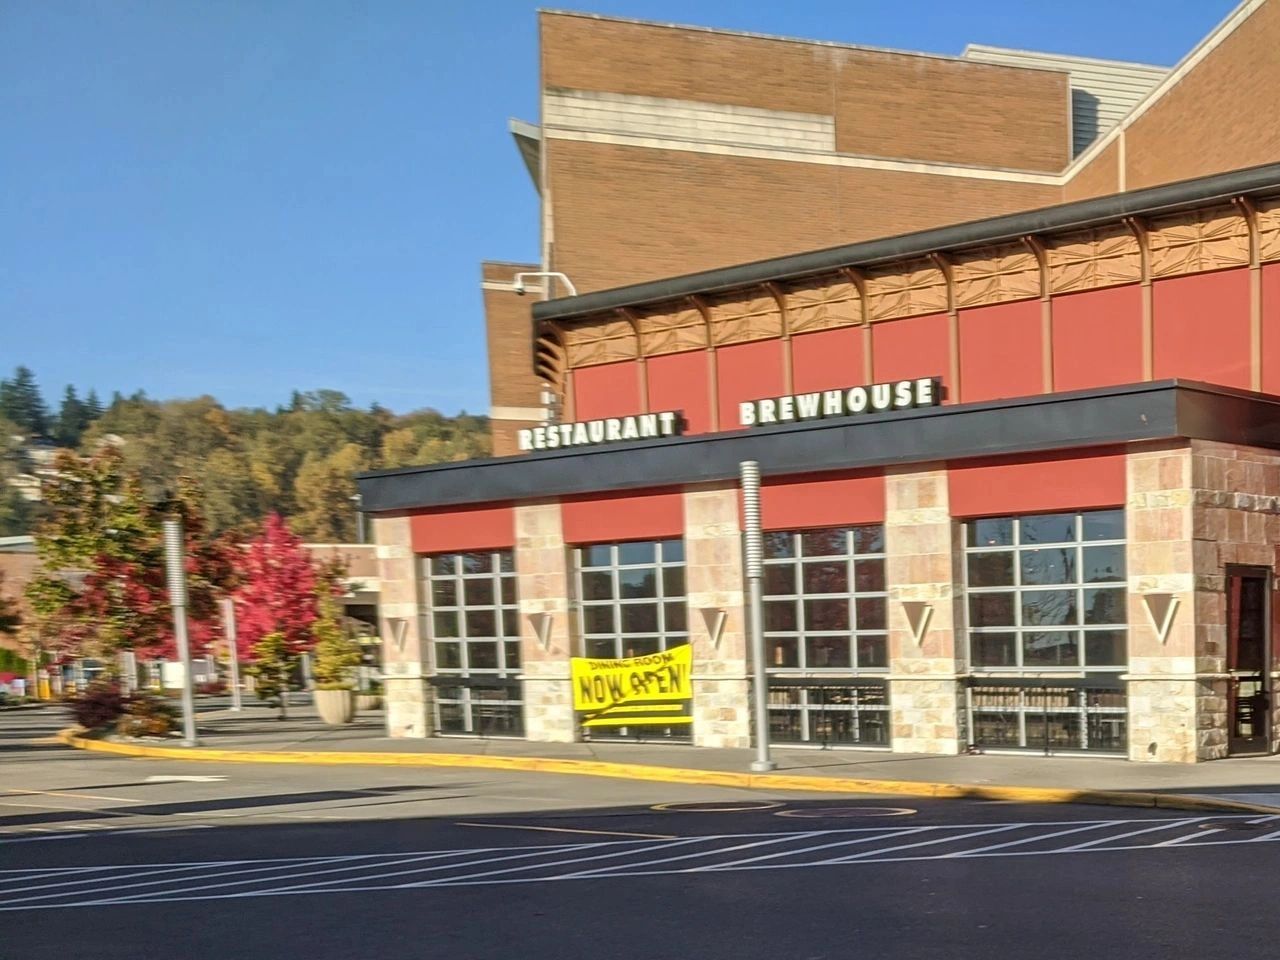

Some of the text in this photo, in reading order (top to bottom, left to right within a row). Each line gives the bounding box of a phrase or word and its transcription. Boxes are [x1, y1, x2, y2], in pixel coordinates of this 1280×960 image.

[517, 378, 933, 450] RESTAURANT BREWHOUSE
[633, 652, 675, 667] ROOM
[578, 673, 627, 704] NOW
